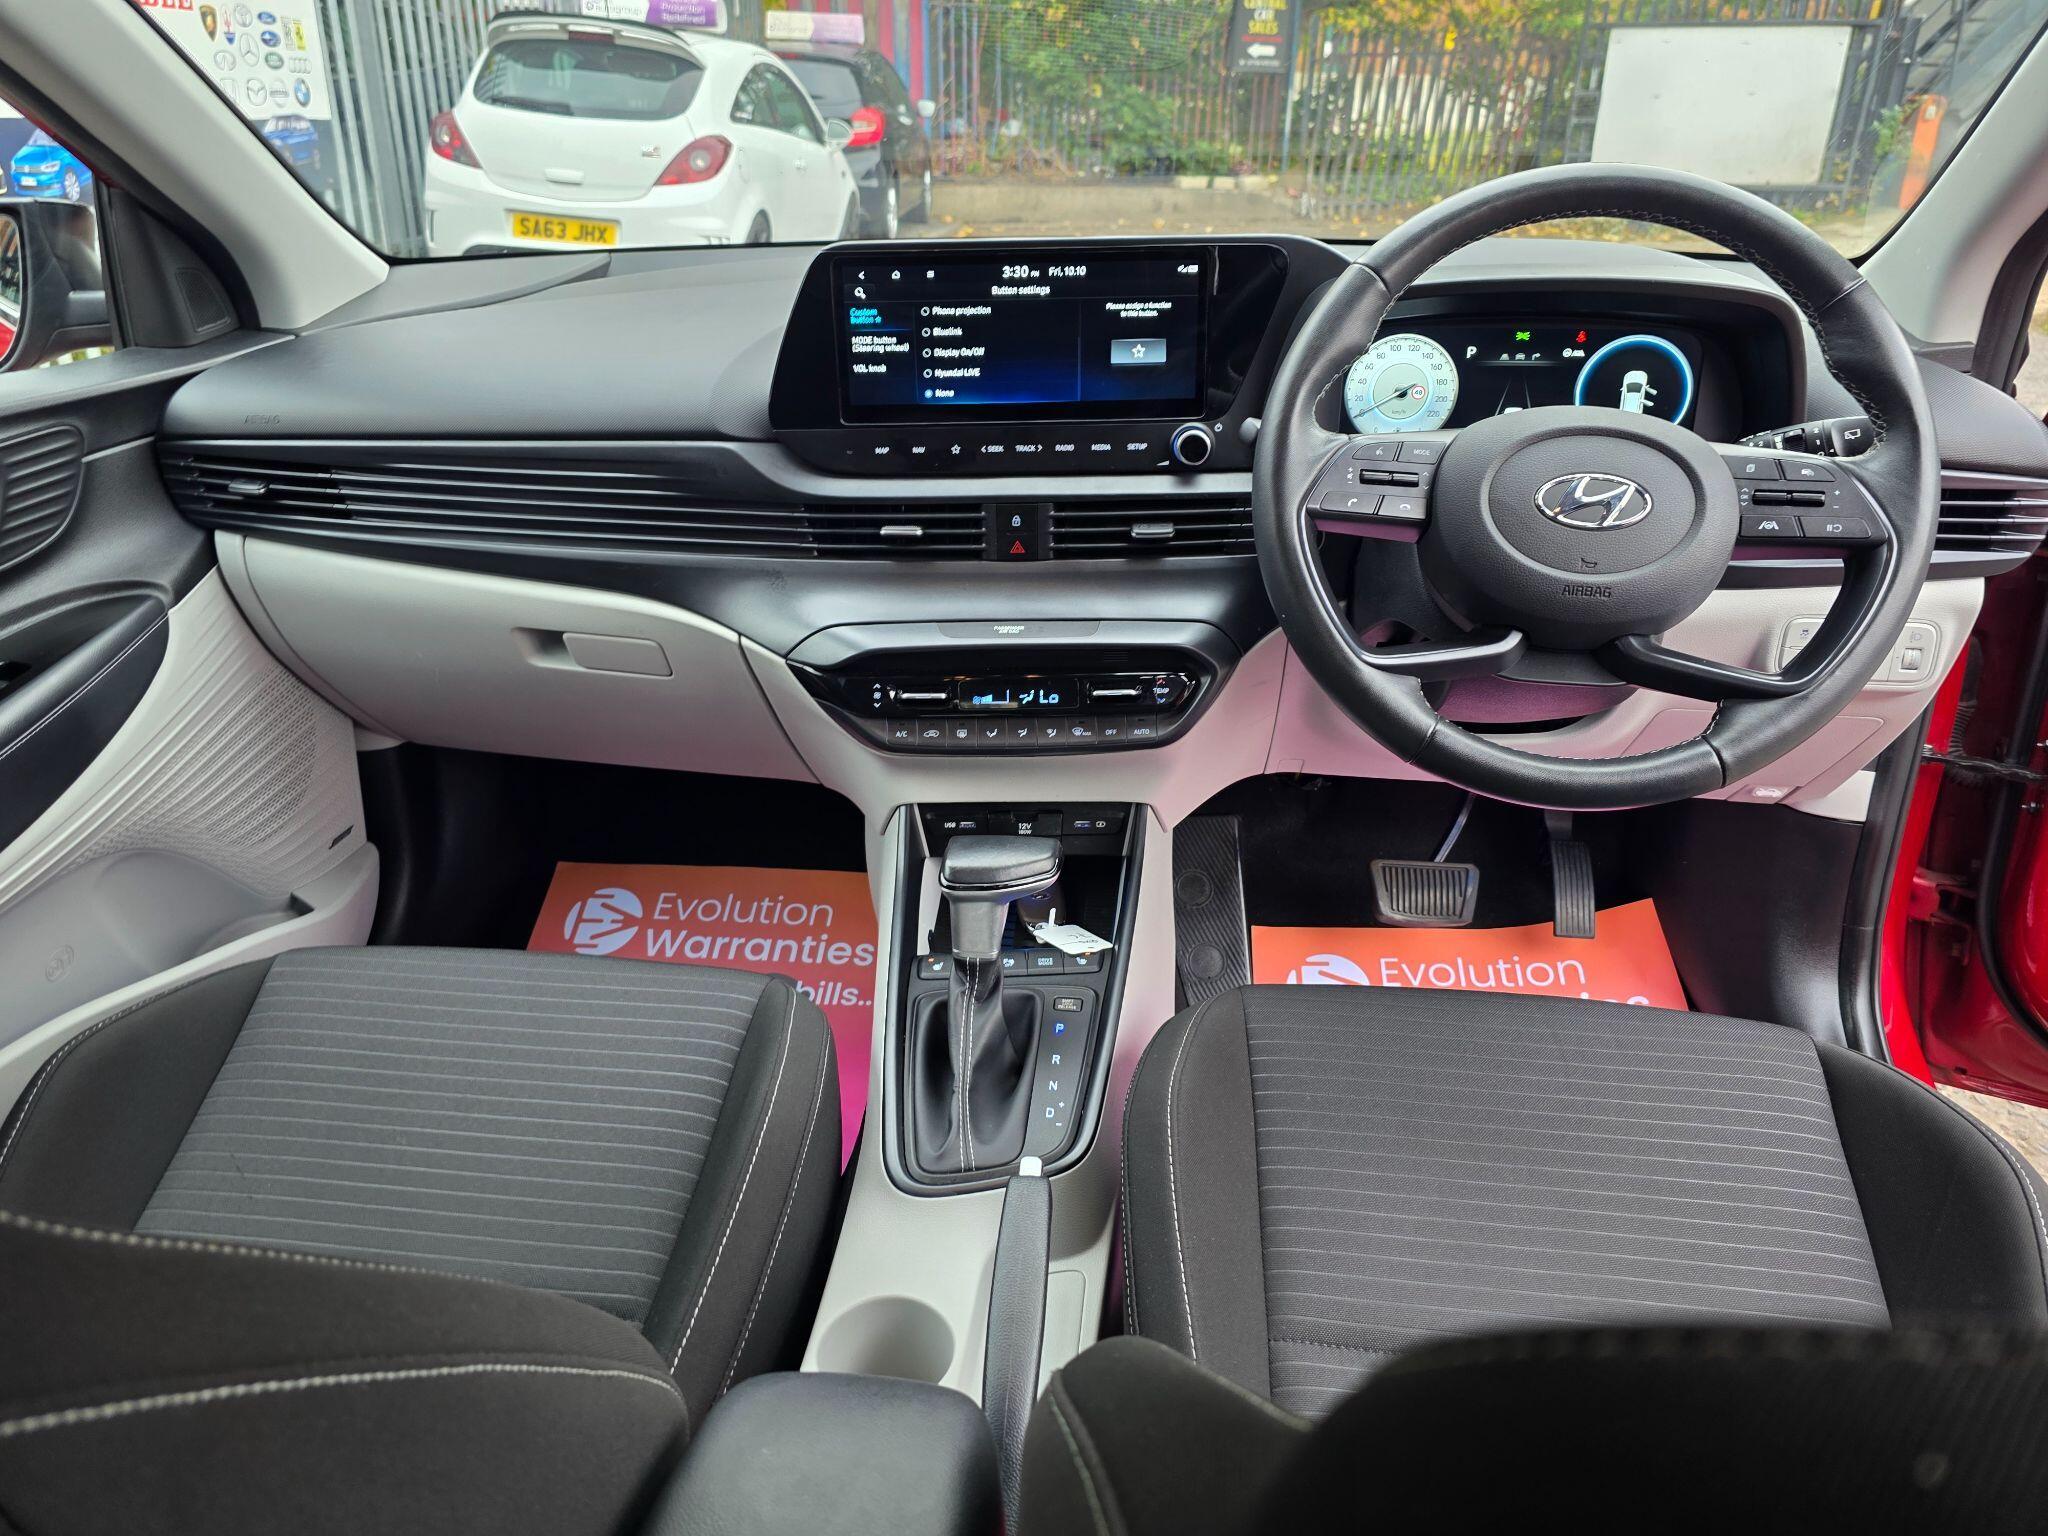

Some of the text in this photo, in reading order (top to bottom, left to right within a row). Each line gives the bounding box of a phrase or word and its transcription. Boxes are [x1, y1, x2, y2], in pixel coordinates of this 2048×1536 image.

[520, 217, 608, 243] SA63 JHX
[1002, 265, 1029, 278] 3:30
[991, 285, 1050, 296] Button settings
[849, 307, 877, 317] Custom
[931, 305, 992, 316] Phone projection
[850, 316, 873, 325] button
[932, 327, 963, 336] Bluelink
[851, 336, 897, 345] MODE button
[933, 347, 960, 358] Display
[1390, 344, 1402, 352] 100
[1408, 344, 1421, 352] 120
[1466, 346, 1477, 358] P
[1376, 352, 1386, 360] 80
[1422, 352, 1434, 360] 140
[868, 364, 887, 373] knob
[1364, 362, 1374, 370] 60
[1430, 363, 1443, 371] 160
[934, 367, 981, 378] Hyundai LIVE
[1357, 377, 1368, 386] 40
[1436, 378, 1448, 386] 180
[934, 388, 955, 397] None
[1354, 394, 1364, 402] 20
[1434, 395, 1448, 403] 200
[1426, 409, 1440, 418] 220
[987, 445, 1005, 453] SEEK
[1015, 444, 1036, 452] TRACK
[1055, 444, 1075, 452] RADIO
[1091, 443, 1112, 451] MEDIA
[1126, 442, 1148, 451] SETUP
[1413, 448, 1431, 456] MODE
[1561, 584, 1612, 598] AIRBAG
[895, 729, 908, 738] A/C
[1105, 728, 1118, 736] OFF
[1018, 822, 1032, 830] 12V
[653, 892, 834, 927] Evolution
[646, 928, 875, 967] Warranties
[1379, 954, 1586, 989] Evolution
[1055, 1023, 1065, 1034] P
[1052, 1054, 1061, 1065] R
[1048, 1080, 1058, 1091] N
[1046, 1107, 1055, 1118] D
